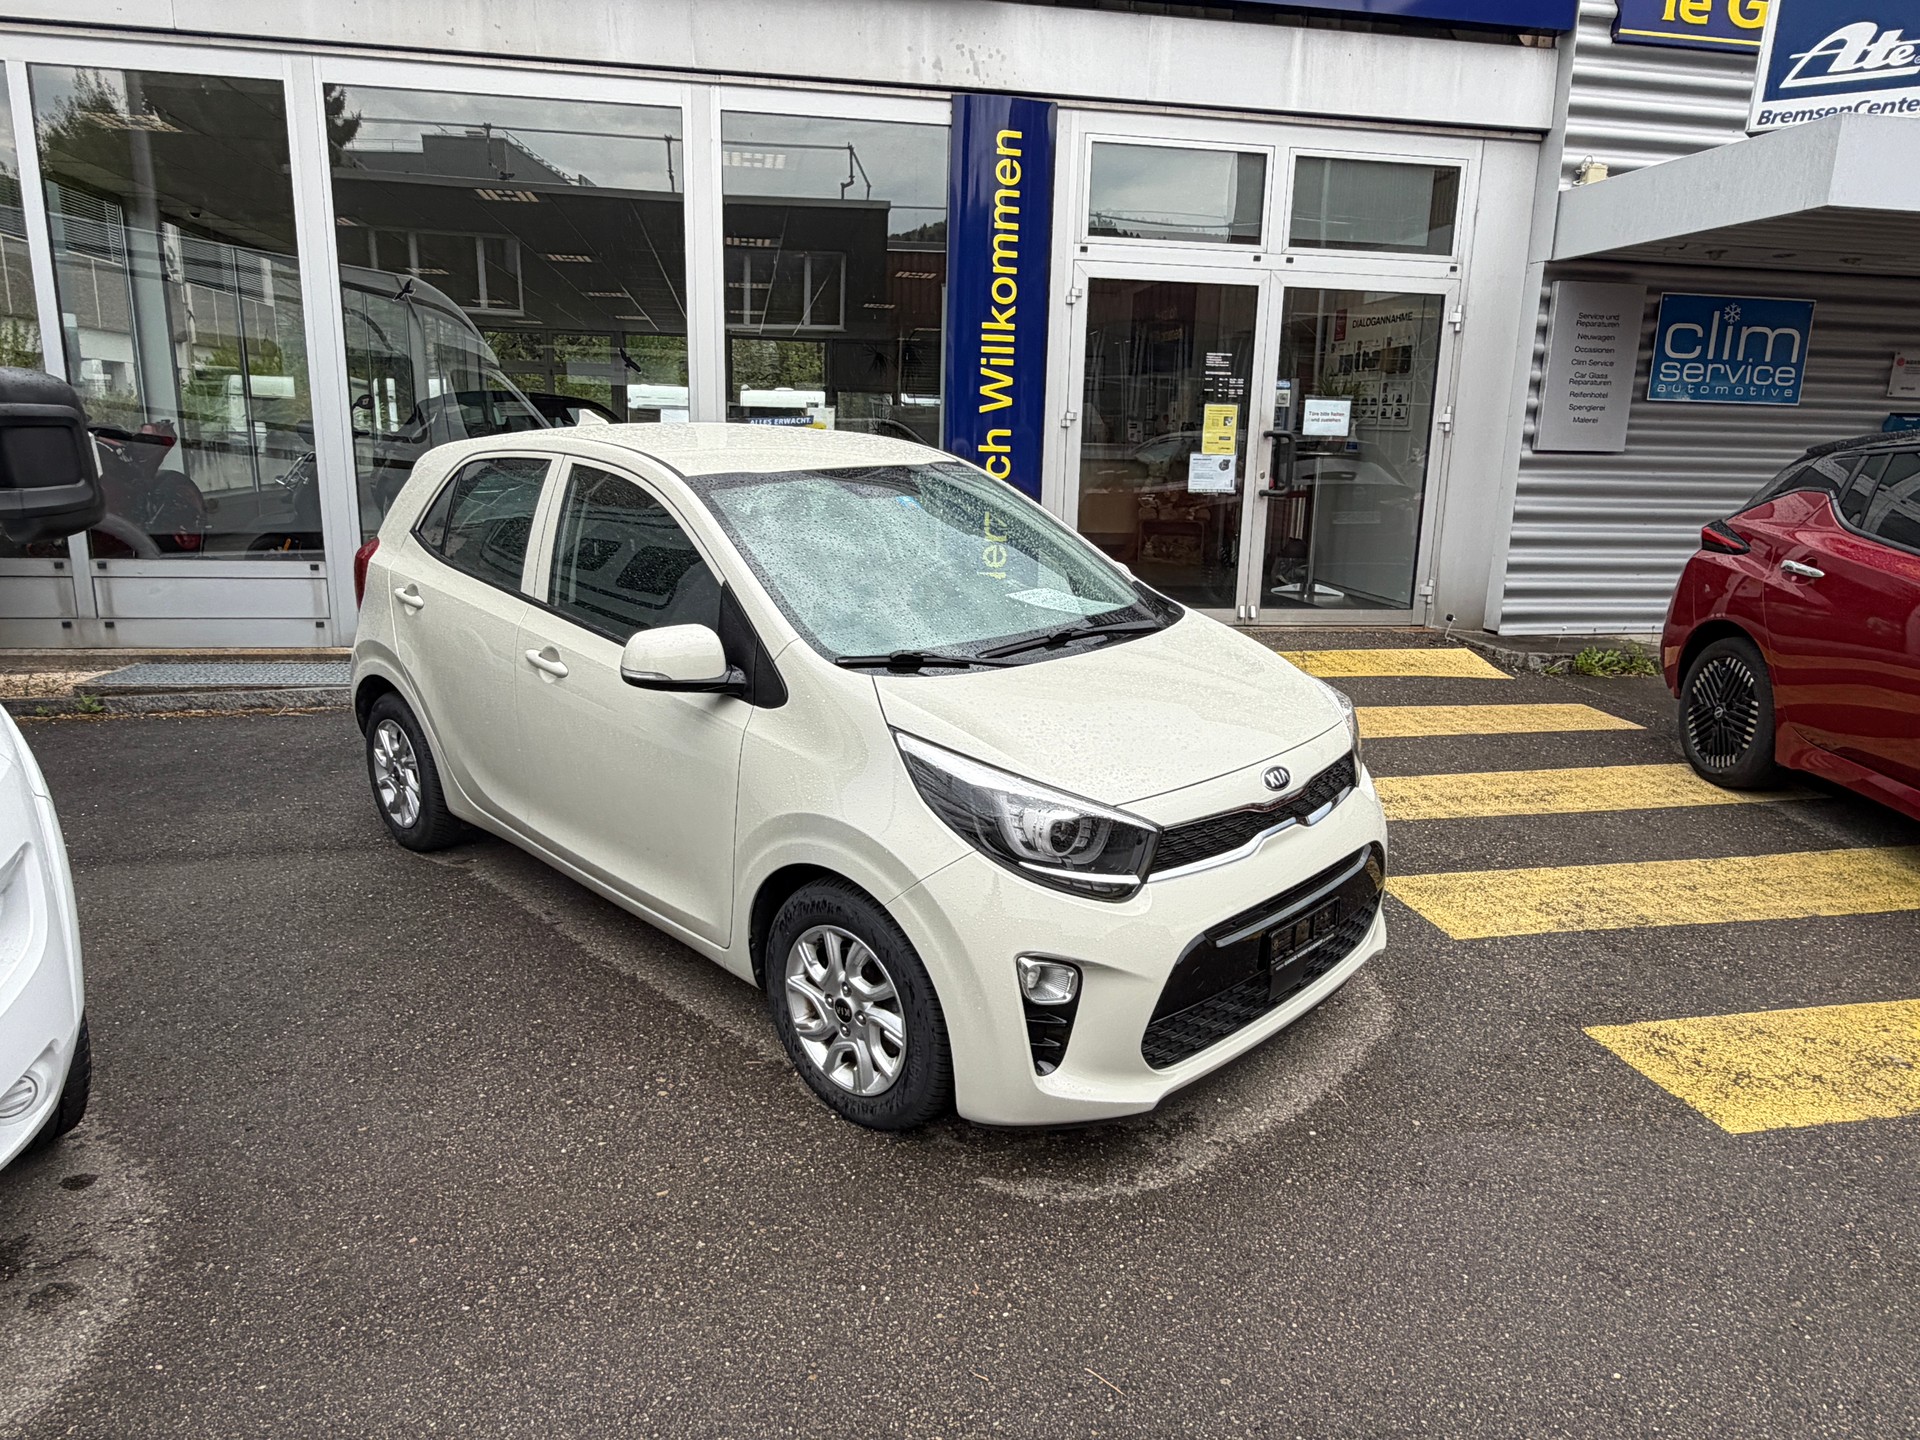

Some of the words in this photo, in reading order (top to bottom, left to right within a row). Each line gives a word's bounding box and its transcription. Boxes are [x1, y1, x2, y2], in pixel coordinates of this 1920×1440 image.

[1780, 22, 1917, 86] Ate
[1757, 97, 1920, 125] BremsenCente
[979, 130, 1023, 413] Willkommen
[1352, 311, 1413, 328] DIALOGANNAHME
[1664, 306, 1801, 363] clim
[1588, 359, 1614, 367] Service
[1659, 359, 1796, 386] service
[1657, 383, 1793, 397] automotive
[1265, 768, 1290, 787] KIA
